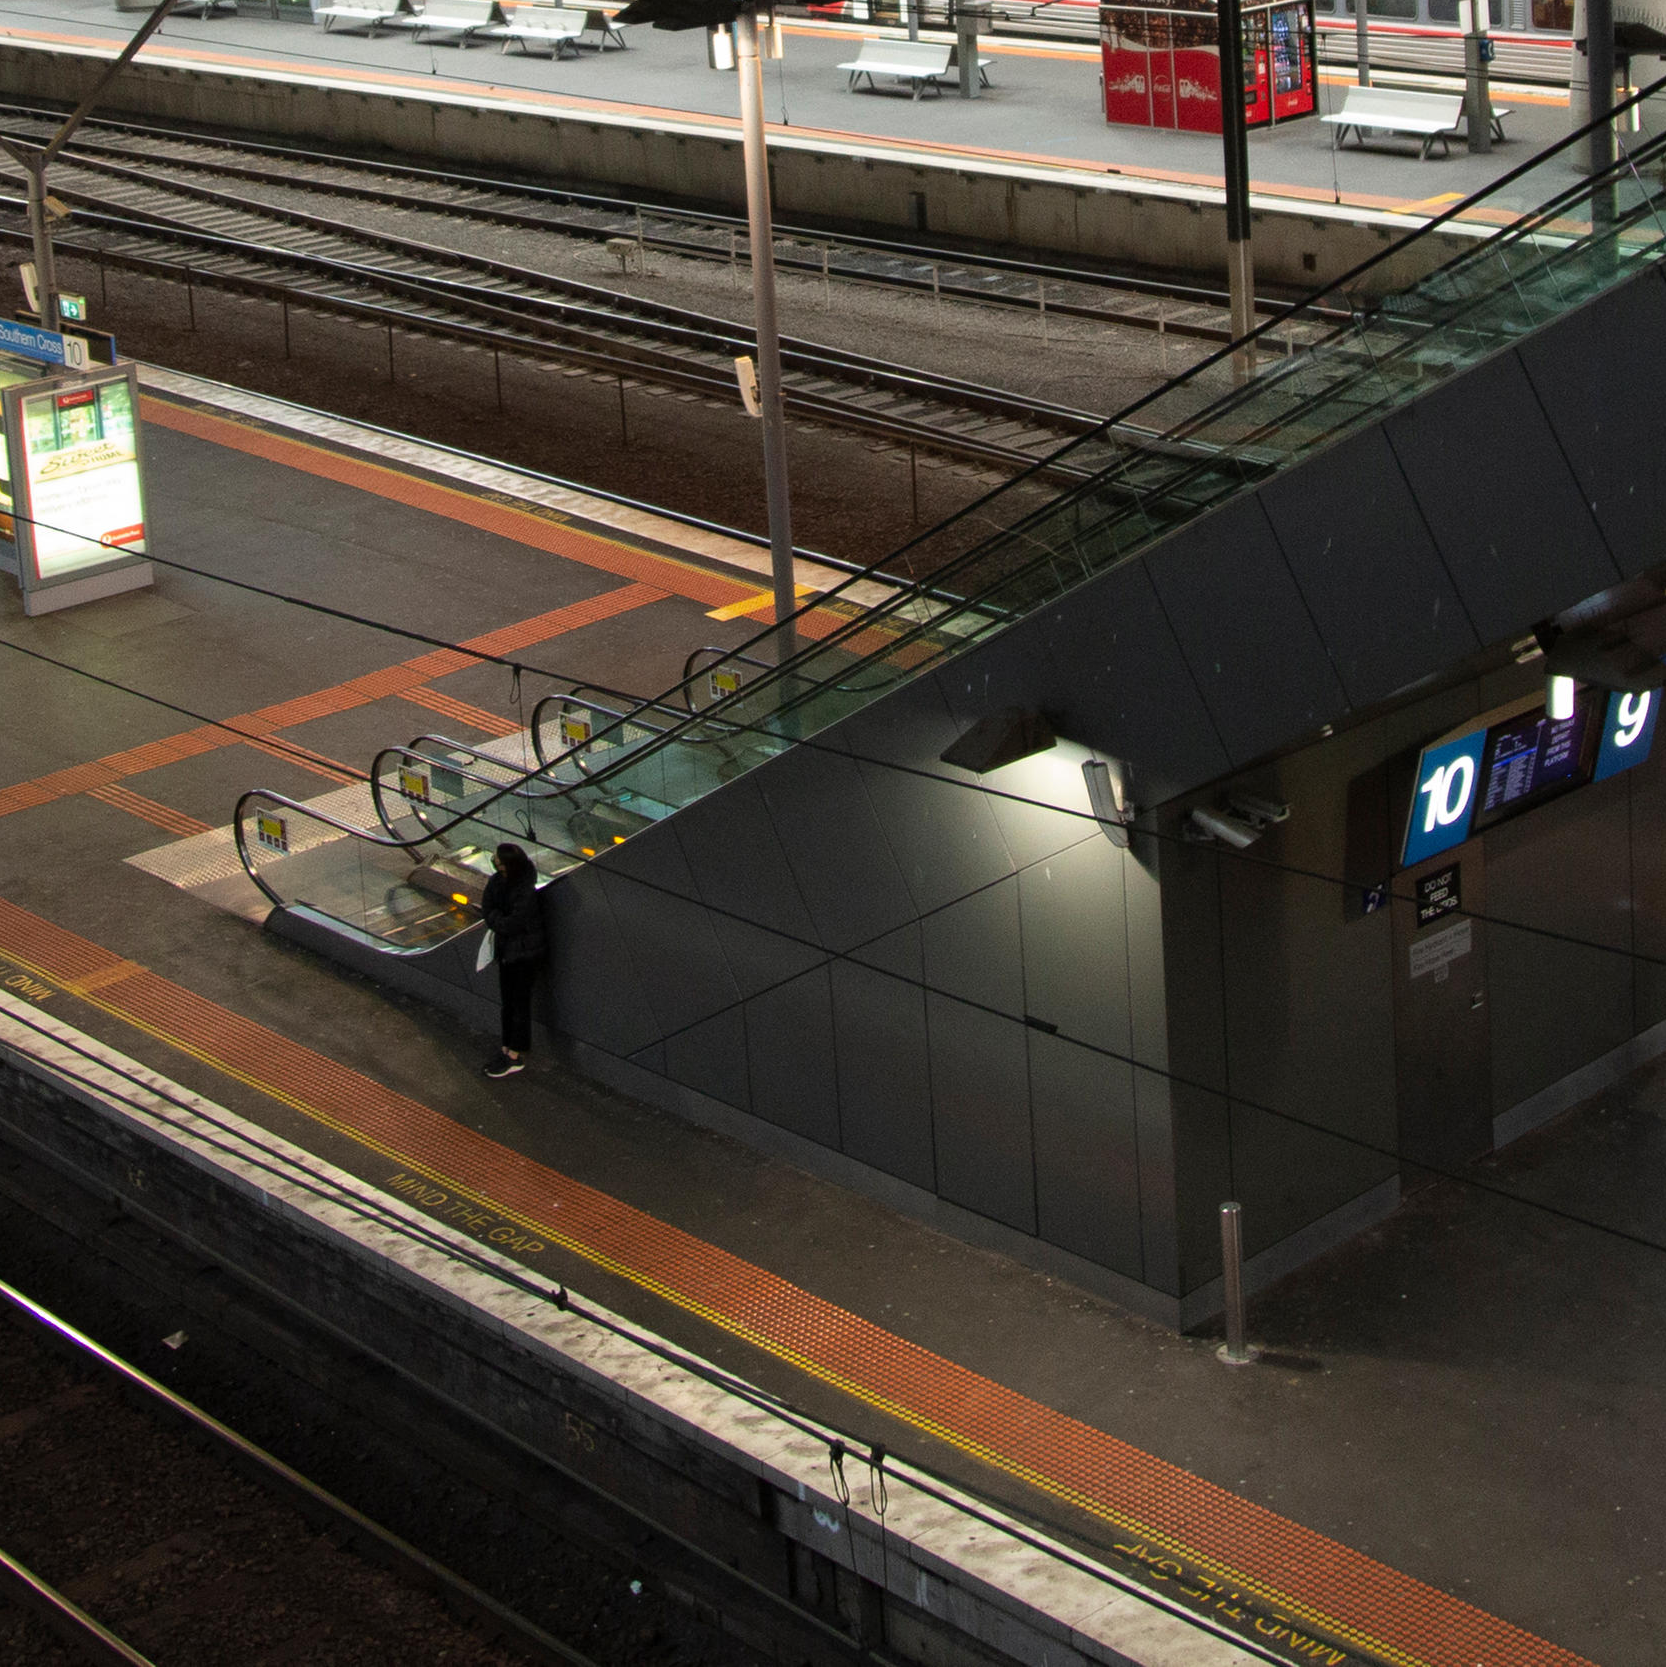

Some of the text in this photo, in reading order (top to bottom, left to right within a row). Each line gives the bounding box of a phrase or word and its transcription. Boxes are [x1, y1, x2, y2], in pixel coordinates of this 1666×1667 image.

[37, 334, 63, 355] Cross
[66, 341, 83, 366] 10
[1421, 755, 1475, 833] 10
[4, 974, 57, 1001] MIND
